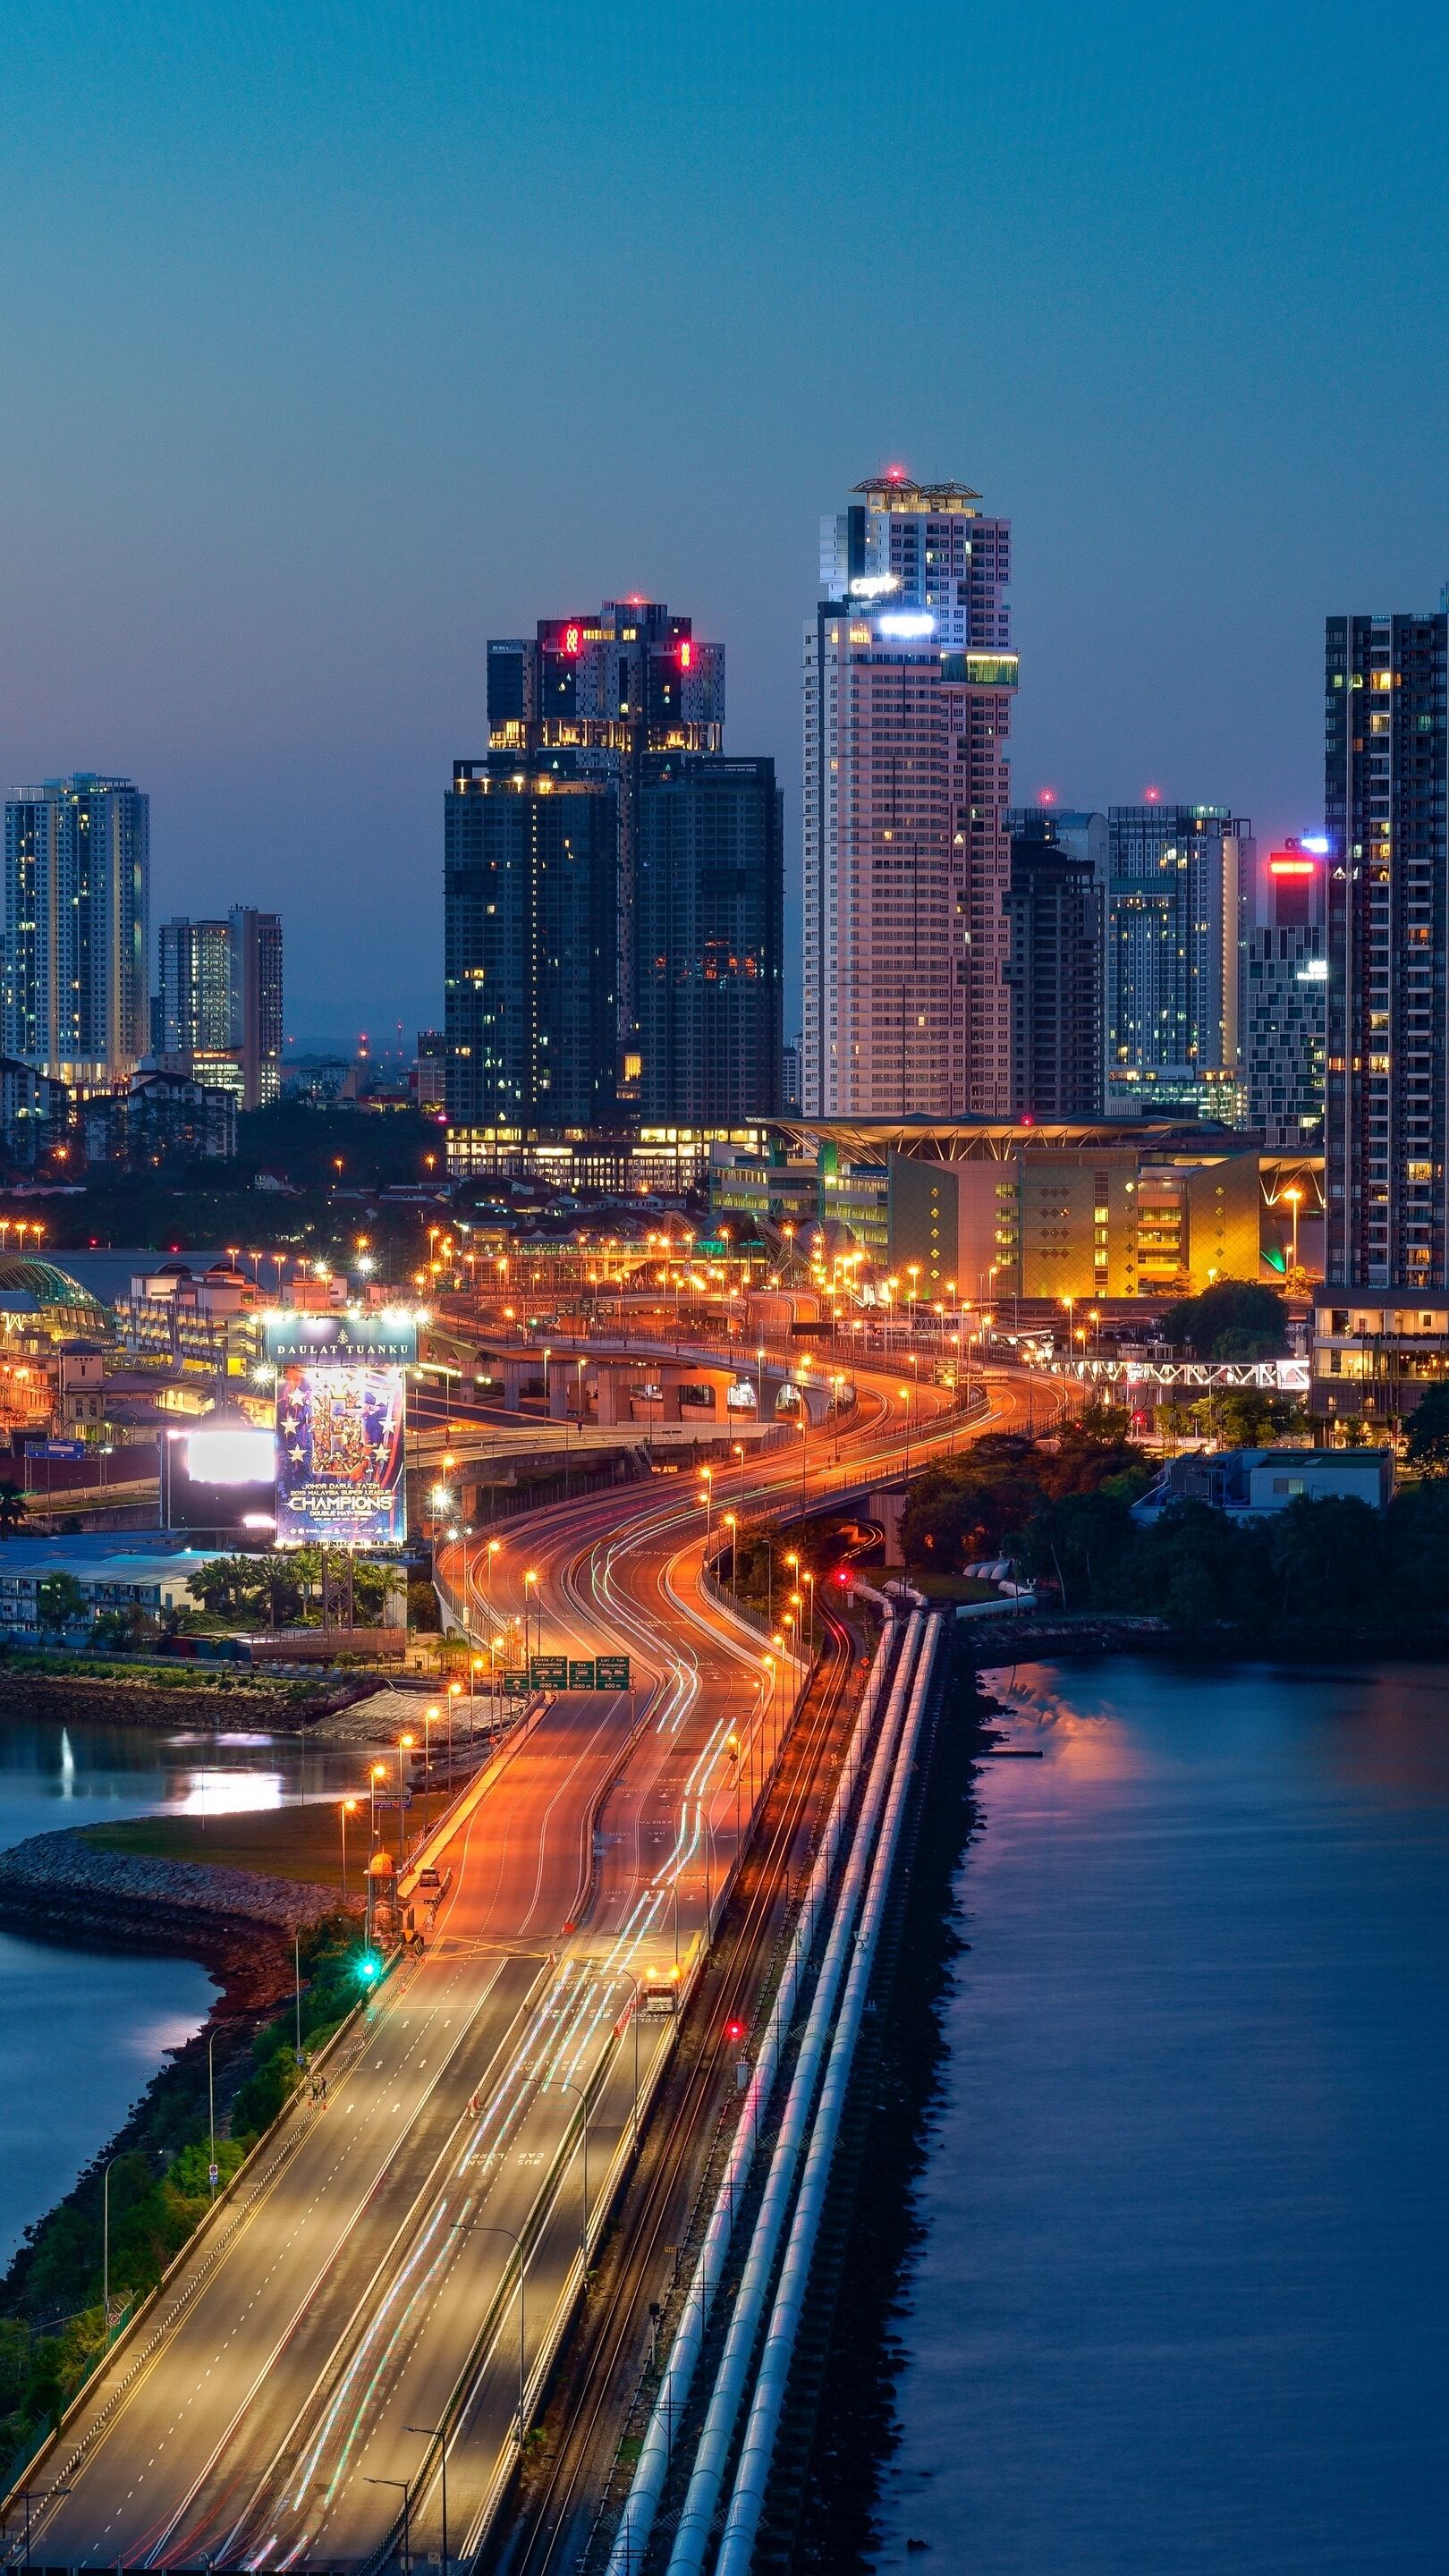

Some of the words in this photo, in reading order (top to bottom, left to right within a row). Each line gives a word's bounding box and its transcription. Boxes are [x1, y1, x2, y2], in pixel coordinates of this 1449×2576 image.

[277, 1344, 338, 1354] DAULAT
[346, 1344, 409, 1354] TUANKU
[288, 1496, 393, 1511] CHAMPIONS
